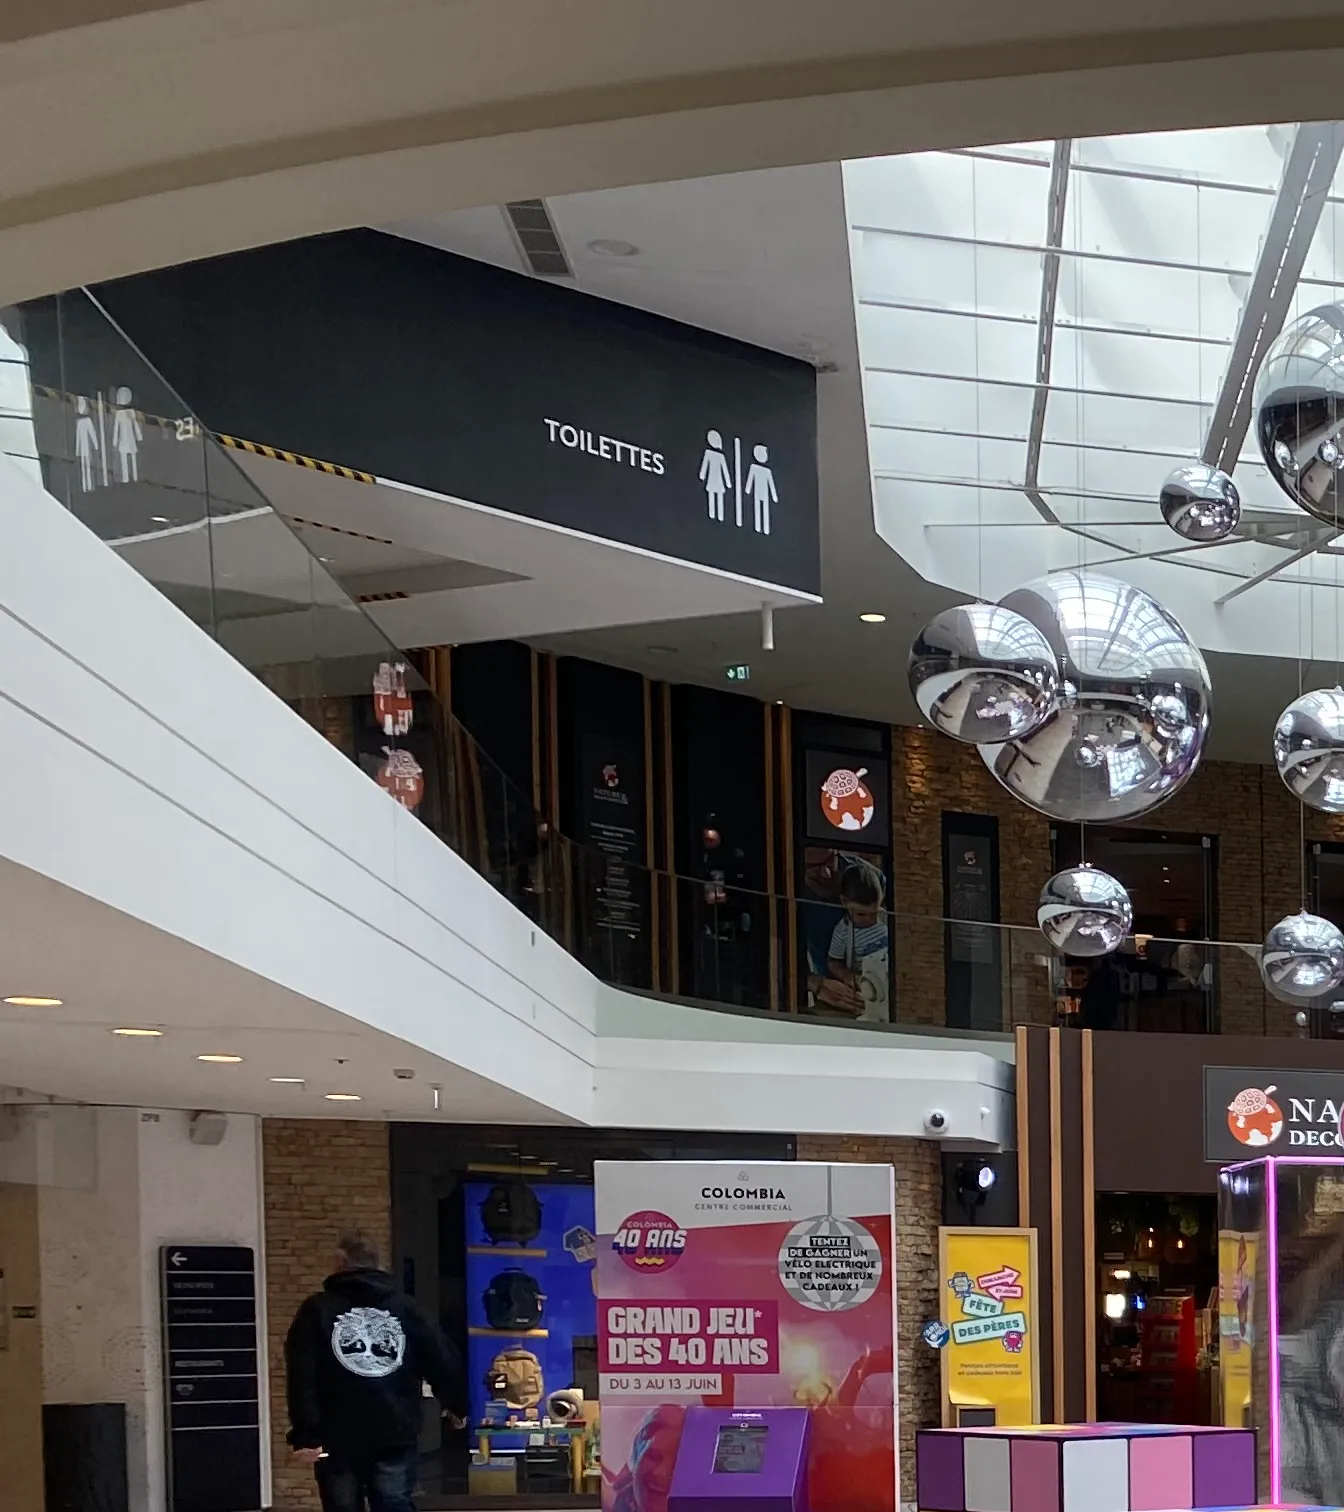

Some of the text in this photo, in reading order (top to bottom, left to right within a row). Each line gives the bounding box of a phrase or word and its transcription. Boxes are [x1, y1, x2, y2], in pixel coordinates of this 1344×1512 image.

[543, 417, 665, 475] TOILETTES
[701, 1186, 786, 1200] COLOMBIA
[694, 1202, 793, 1212] CENTRE COMMERCIAL
[613, 1228, 688, 1248] 40 ANS
[811, 1237, 849, 1246] TENTEZ
[789, 1248, 868, 1258] DE GAGNER UN
[785, 1271, 874, 1280] ET DE NOMBREUX
[802, 1282, 853, 1291] CADEAUX
[969, 1298, 997, 1314] FÊTE
[607, 1307, 700, 1335] GRAND
[958, 1326, 982, 1338] DES
[983, 1317, 1020, 1334] PÈRES
[608, 1338, 769, 1366] DES 40 ANS
[609, 1378, 718, 1391] DU 3 AU 13 JUIN
